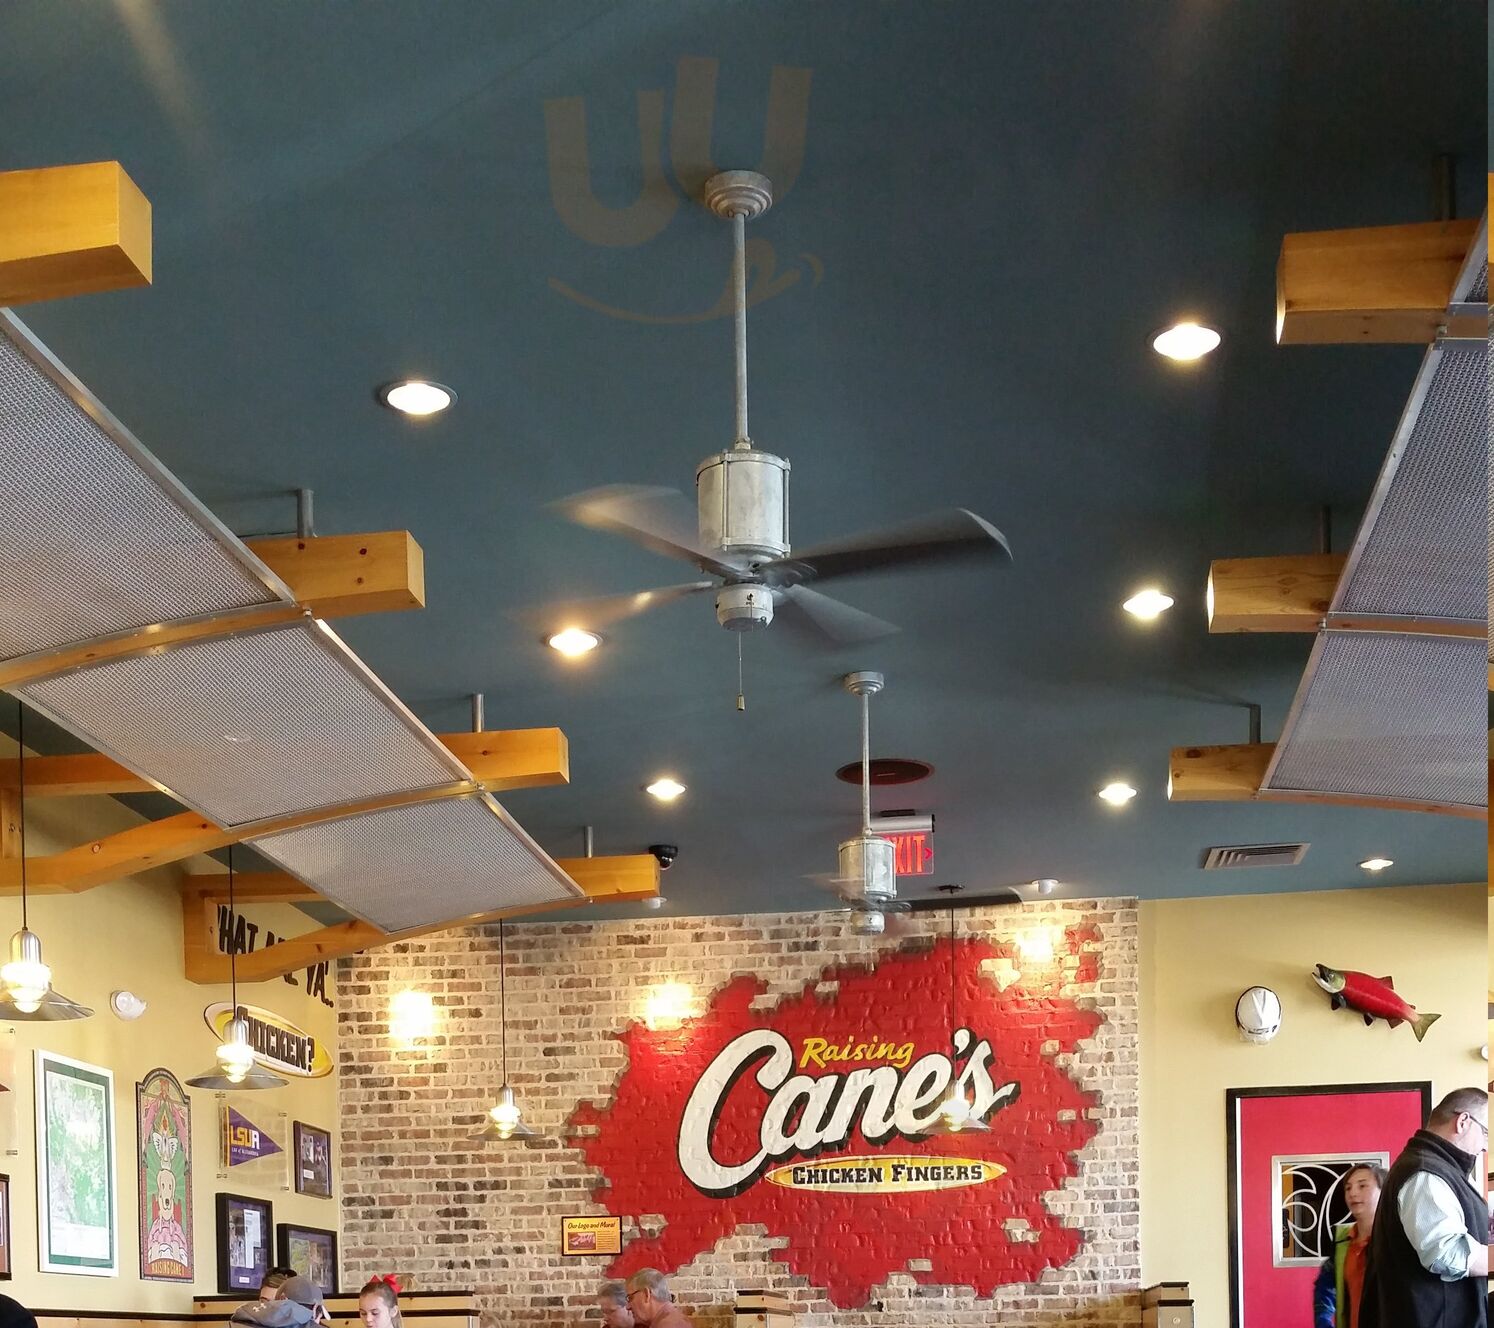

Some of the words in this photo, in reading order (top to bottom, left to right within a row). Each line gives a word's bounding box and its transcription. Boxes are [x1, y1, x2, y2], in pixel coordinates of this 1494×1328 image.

[885, 834, 926, 873] XIT
[217, 903, 258, 955] HAT
[799, 1035, 915, 1068] Raising
[677, 1028, 1021, 1198] Cane's
[230, 1125, 260, 1150] LSUA
[792, 1166, 883, 1185] CHICKEN
[891, 1164, 983, 1182] FINGERS
[567, 1222, 578, 1230] Our
[578, 1222, 590, 1230] Logo
